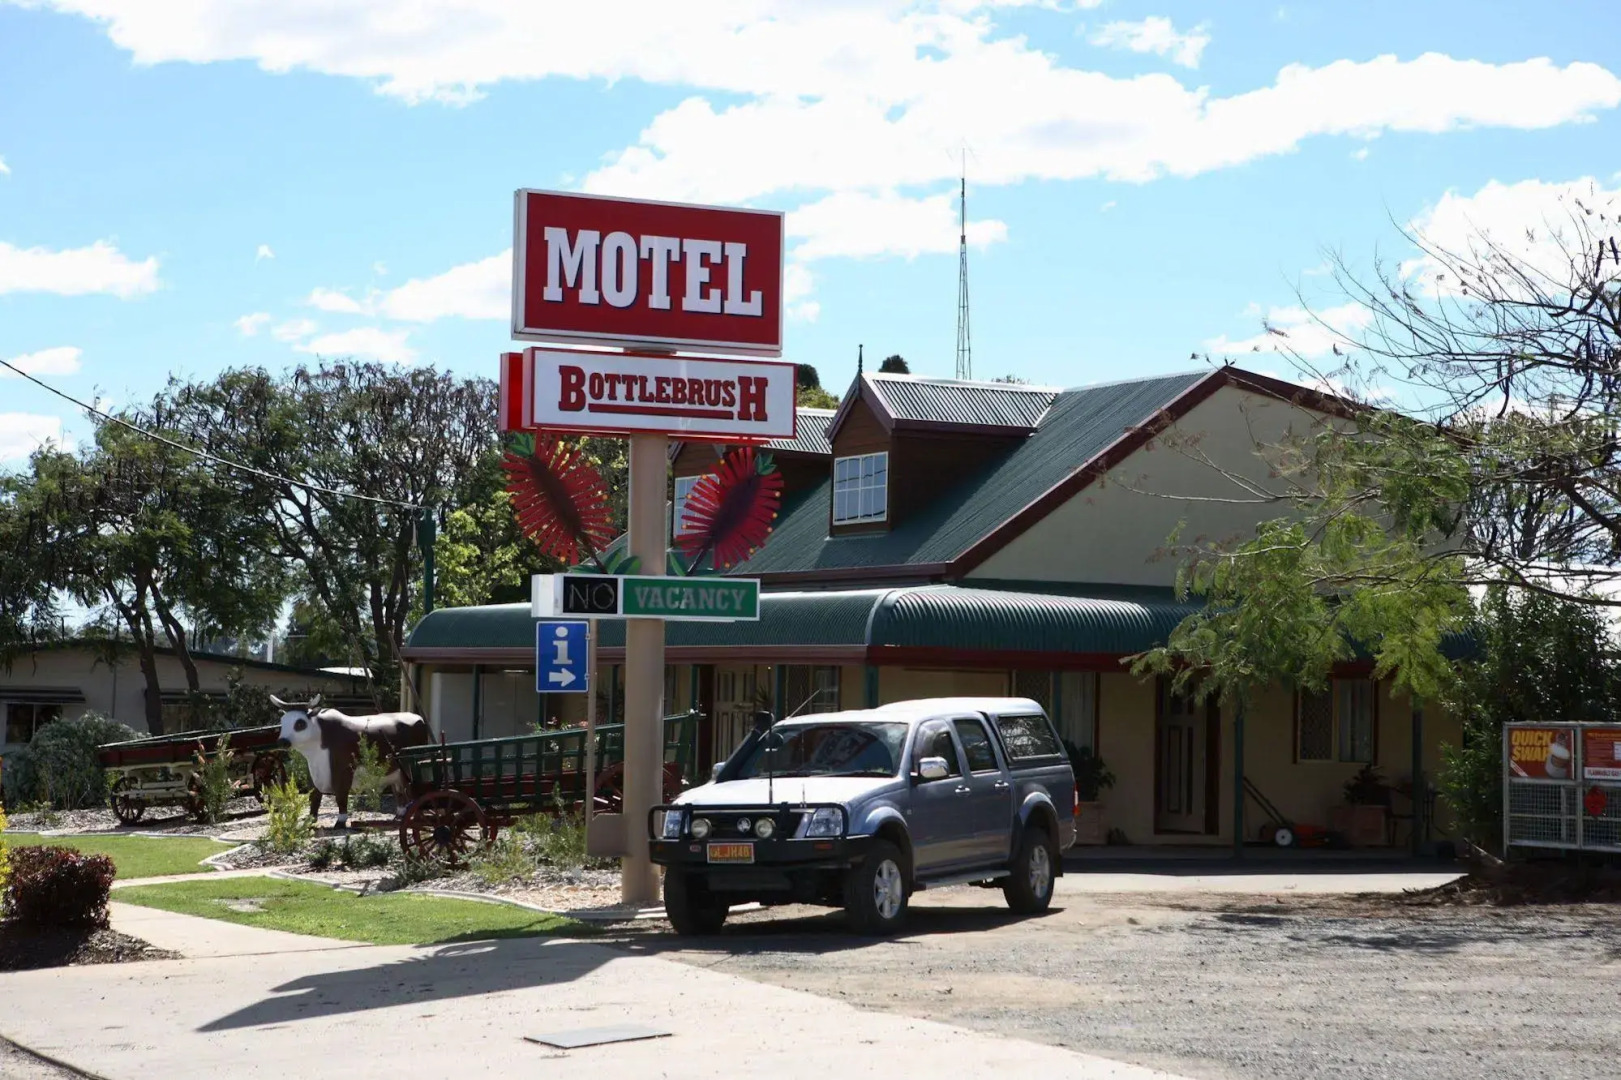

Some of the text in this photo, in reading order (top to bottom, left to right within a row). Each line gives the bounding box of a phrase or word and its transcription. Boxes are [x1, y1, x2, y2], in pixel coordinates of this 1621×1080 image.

[543, 226, 763, 317] MOTEL
[558, 365, 769, 421] BOTTLEBRUSH
[568, 582, 747, 611] NO VACANCY
[1512, 731, 1552, 746] QUICK
